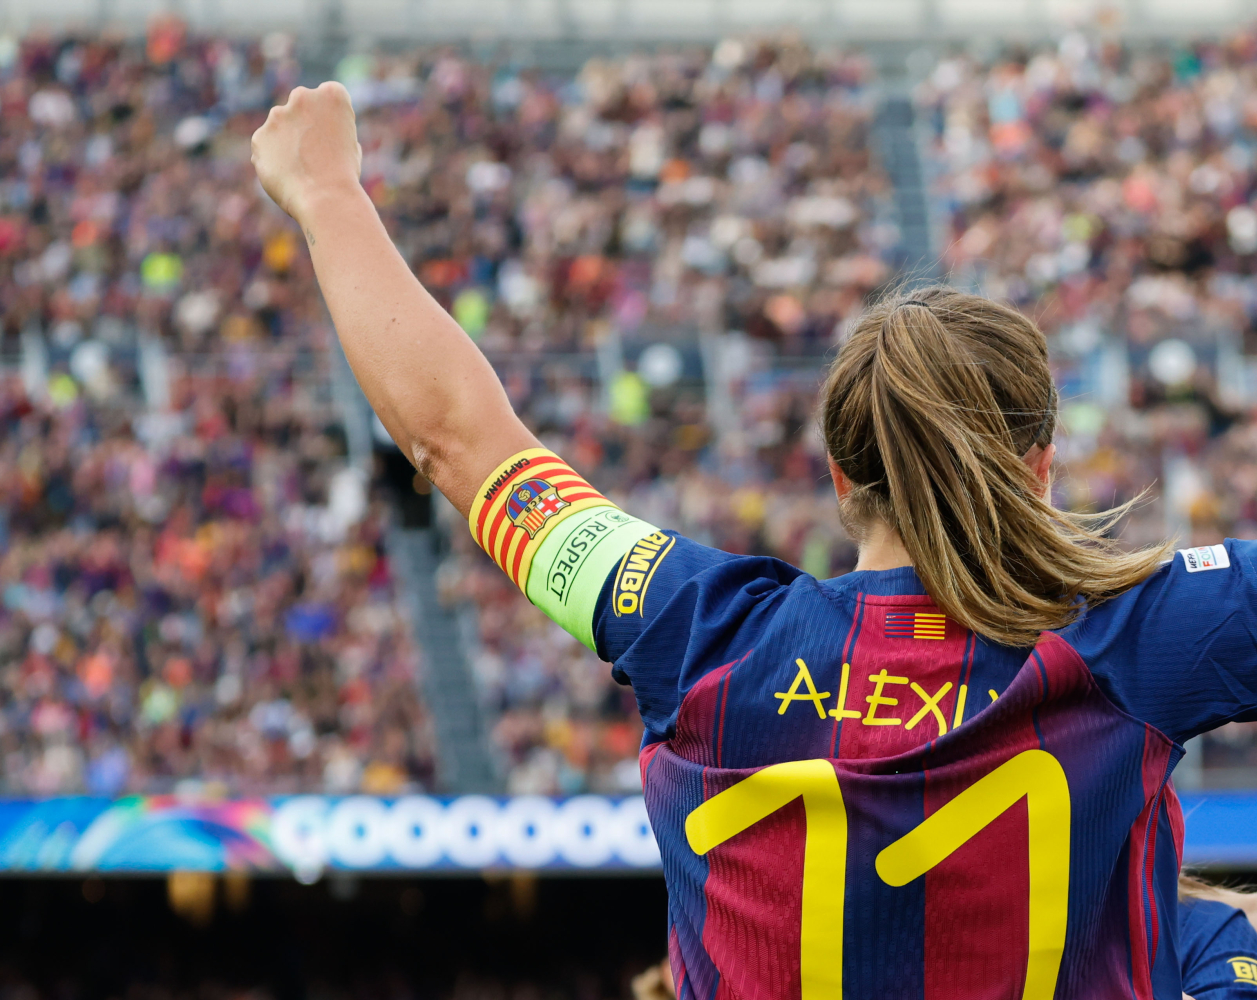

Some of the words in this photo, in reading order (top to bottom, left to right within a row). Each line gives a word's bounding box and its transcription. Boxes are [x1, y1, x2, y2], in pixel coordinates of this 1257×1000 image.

[484, 458, 531, 501] CAPITANA
[550, 520, 608, 603] RESPECT
[774, 658, 999, 737] ALEXI
